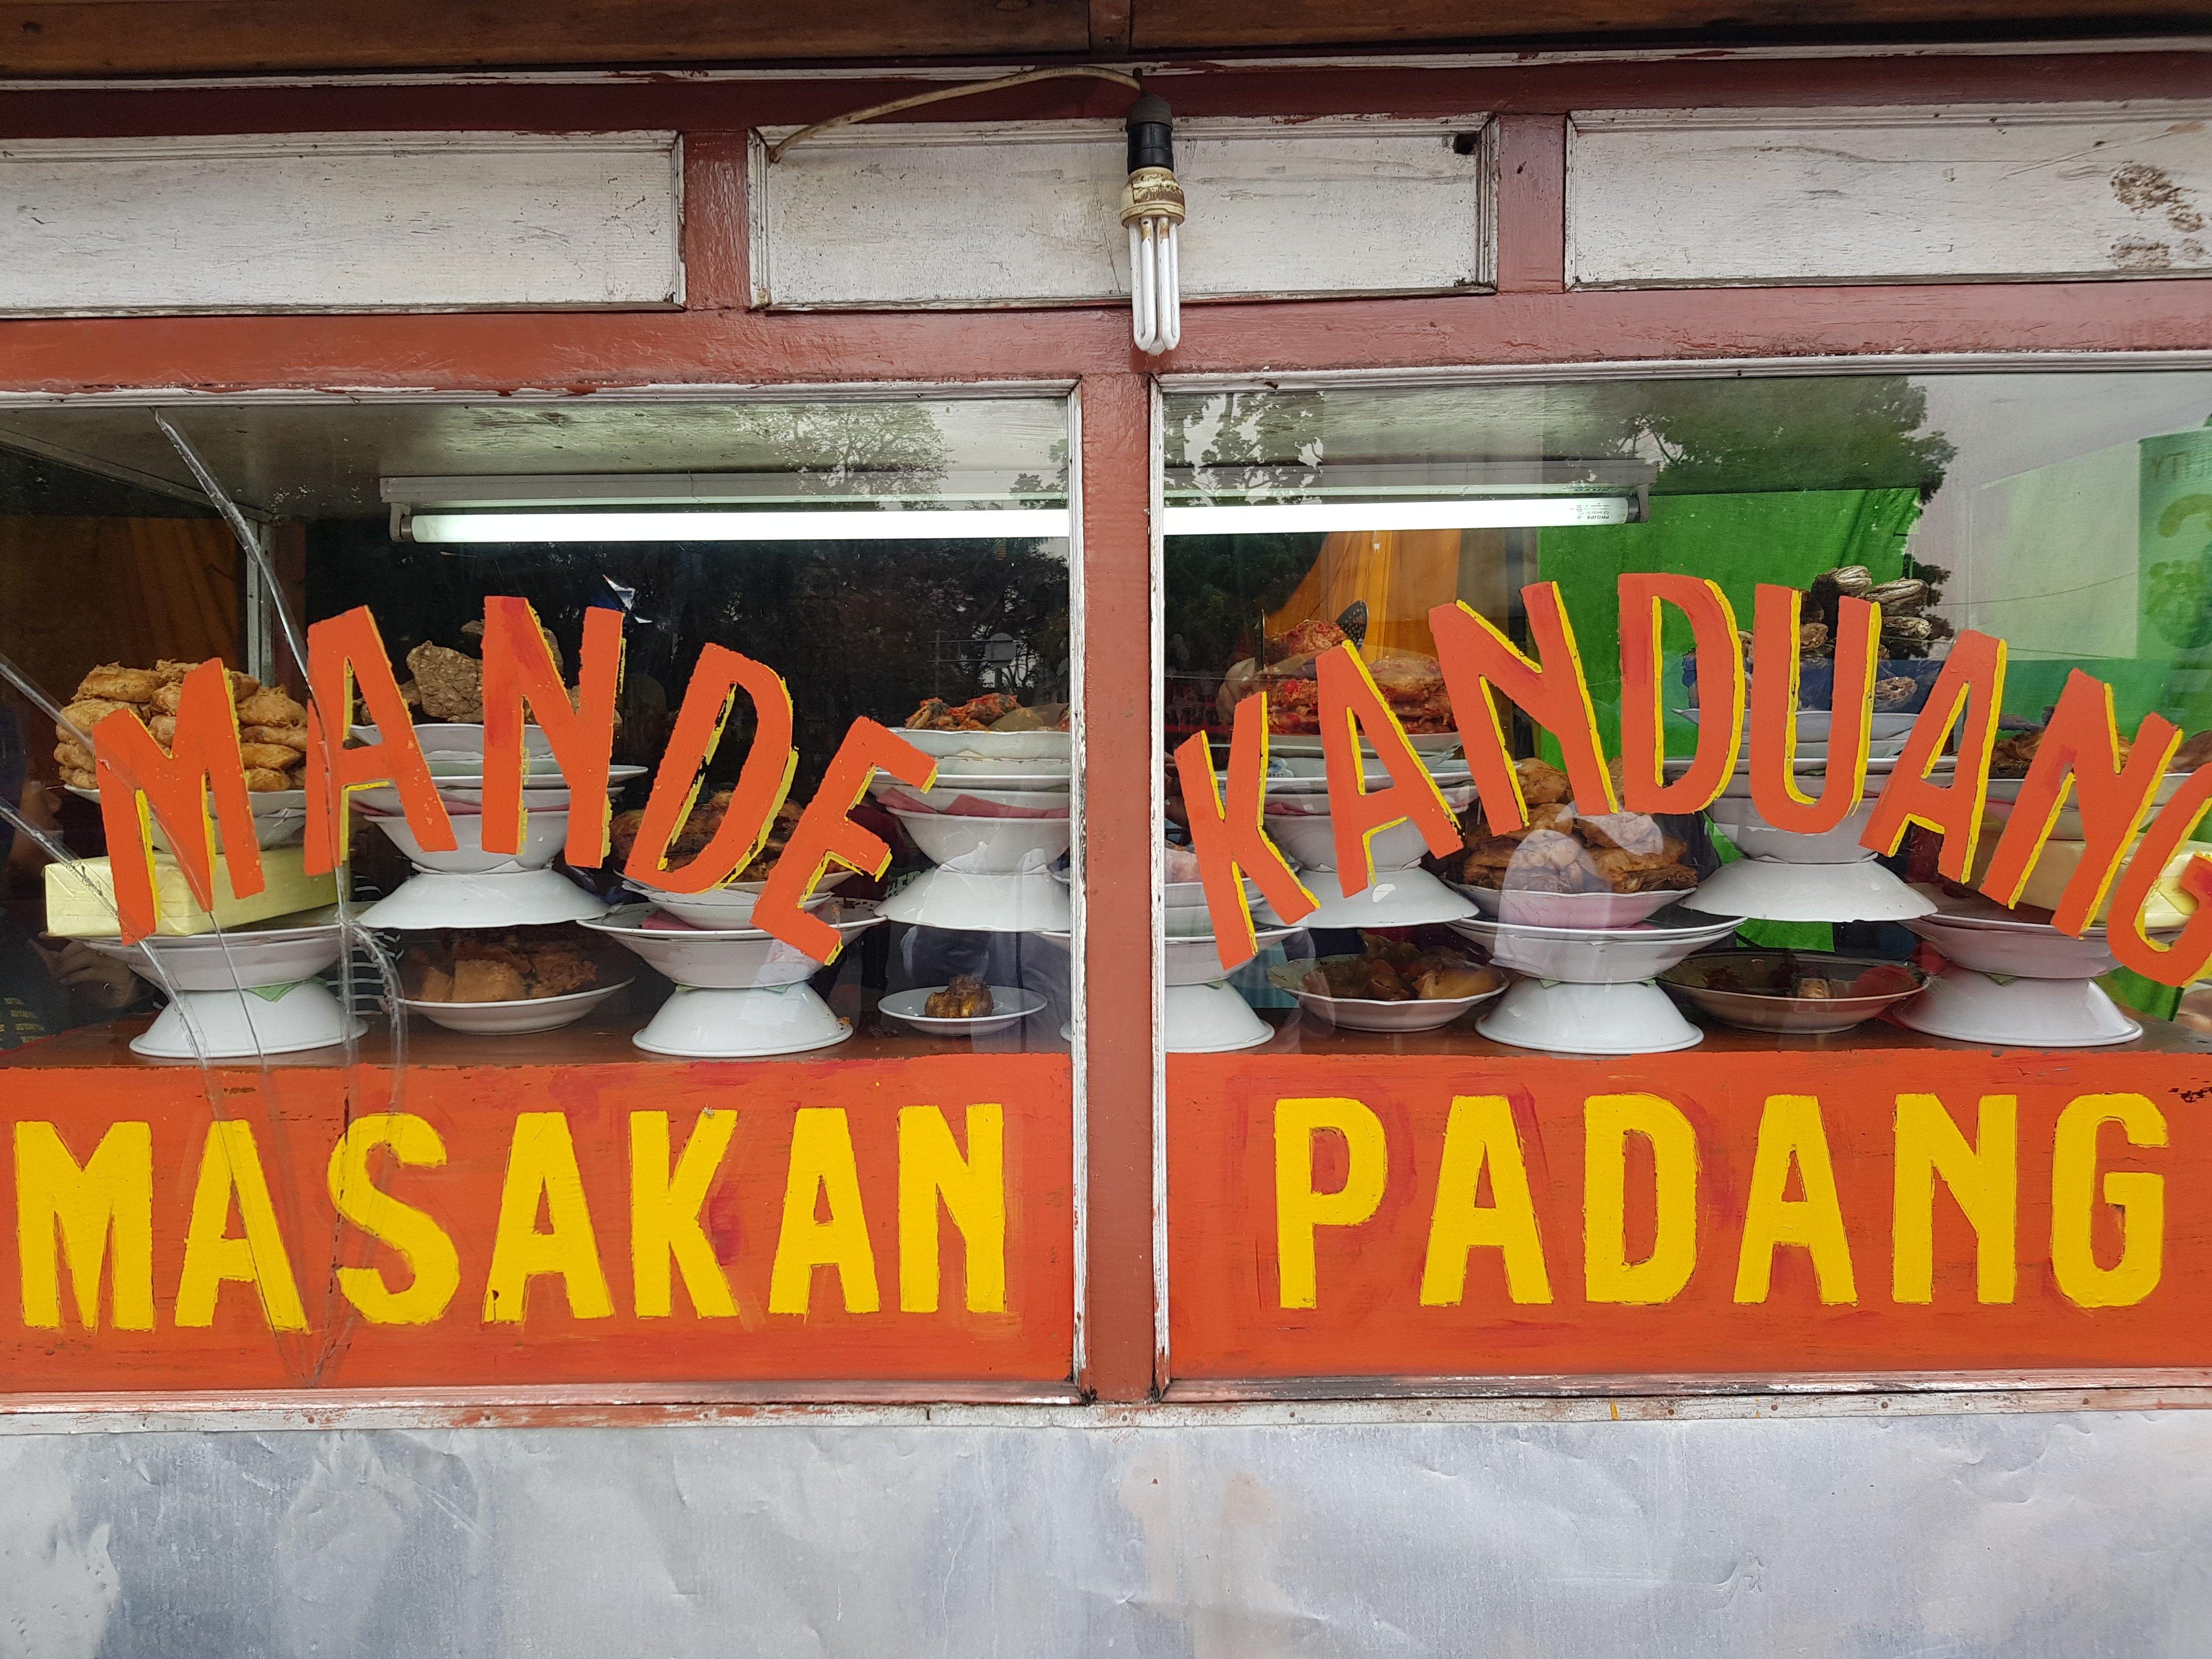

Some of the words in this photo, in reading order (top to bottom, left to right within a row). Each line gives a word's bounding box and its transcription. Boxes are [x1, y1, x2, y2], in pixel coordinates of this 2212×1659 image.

[91, 596, 938, 967] MANDE
[1174, 573, 2212, 988] KANDUANG
[13, 1103, 1007, 1332] MASAKAN
[1273, 1092, 2168, 1310] PADANG
